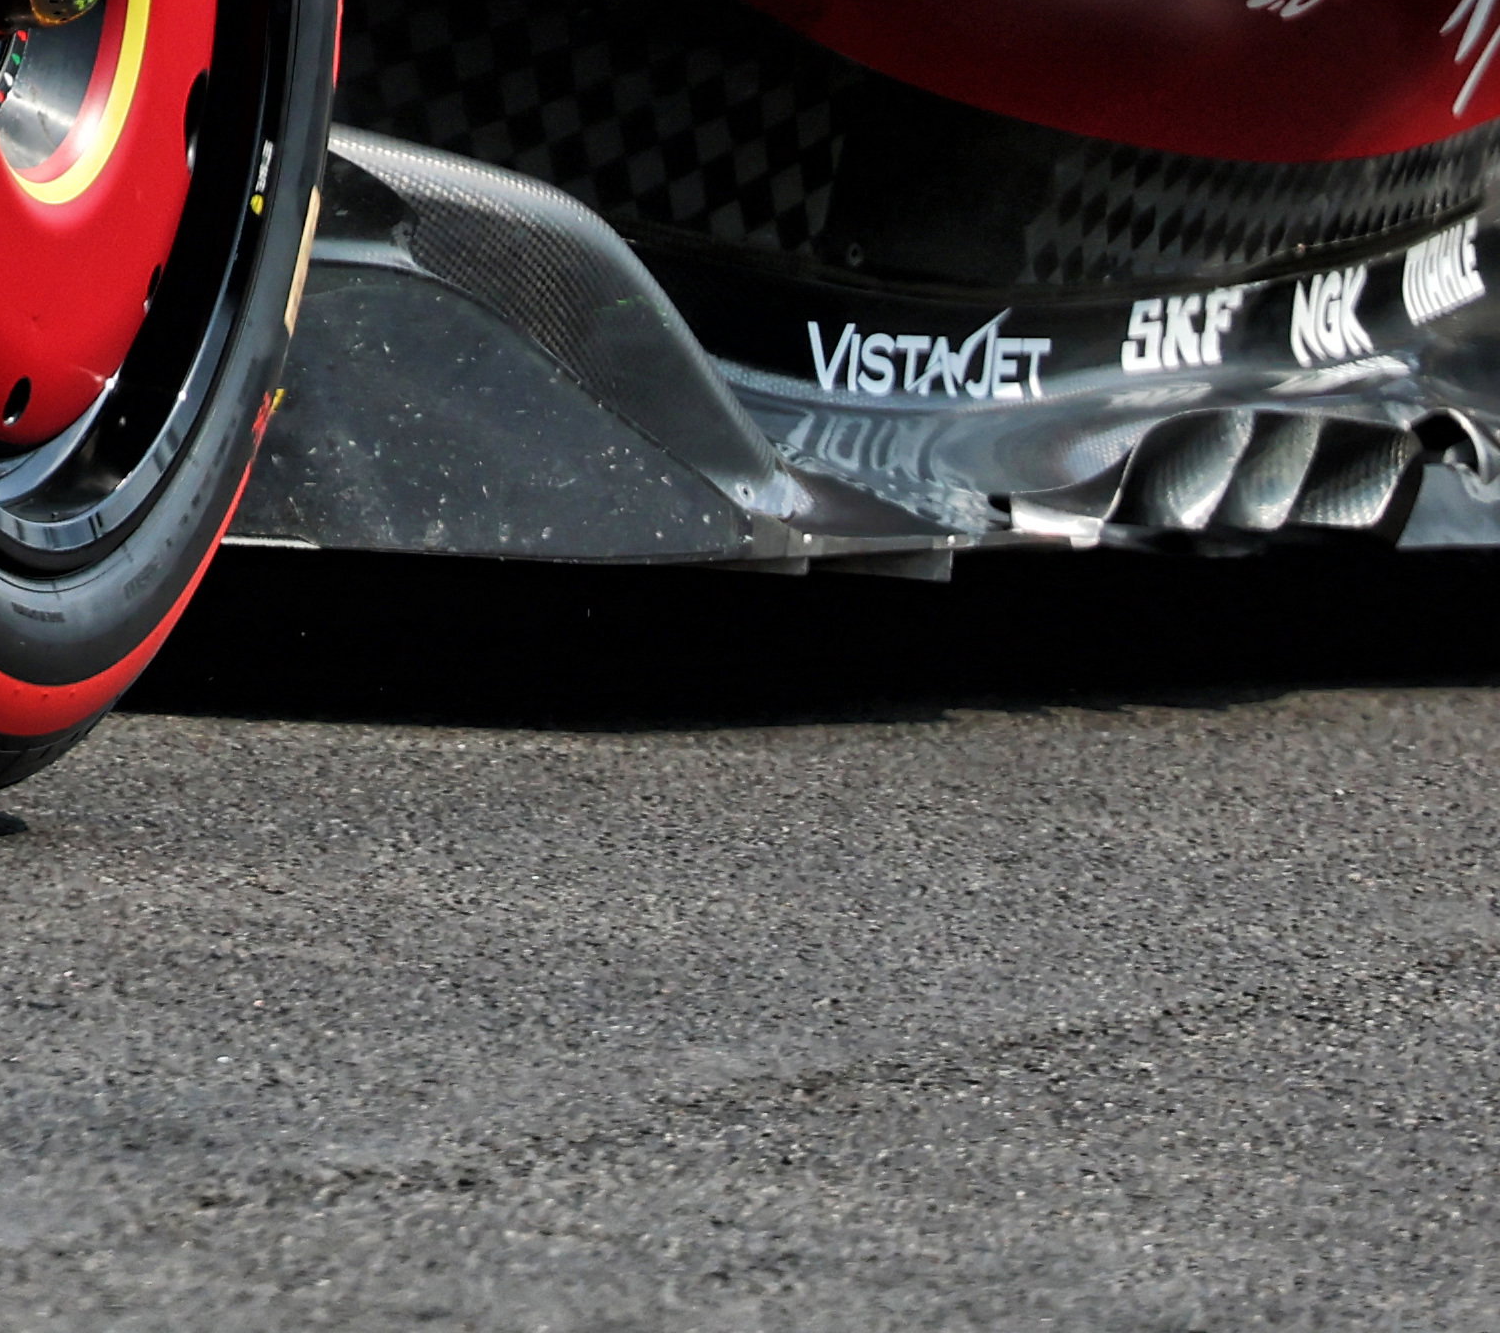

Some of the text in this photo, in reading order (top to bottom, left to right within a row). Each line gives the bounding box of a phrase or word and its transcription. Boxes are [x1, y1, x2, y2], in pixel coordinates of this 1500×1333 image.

[1290, 266, 1374, 368] NGK
[1402, 215, 1486, 327] MAHLE
[1120, 288, 1242, 373] SKF
